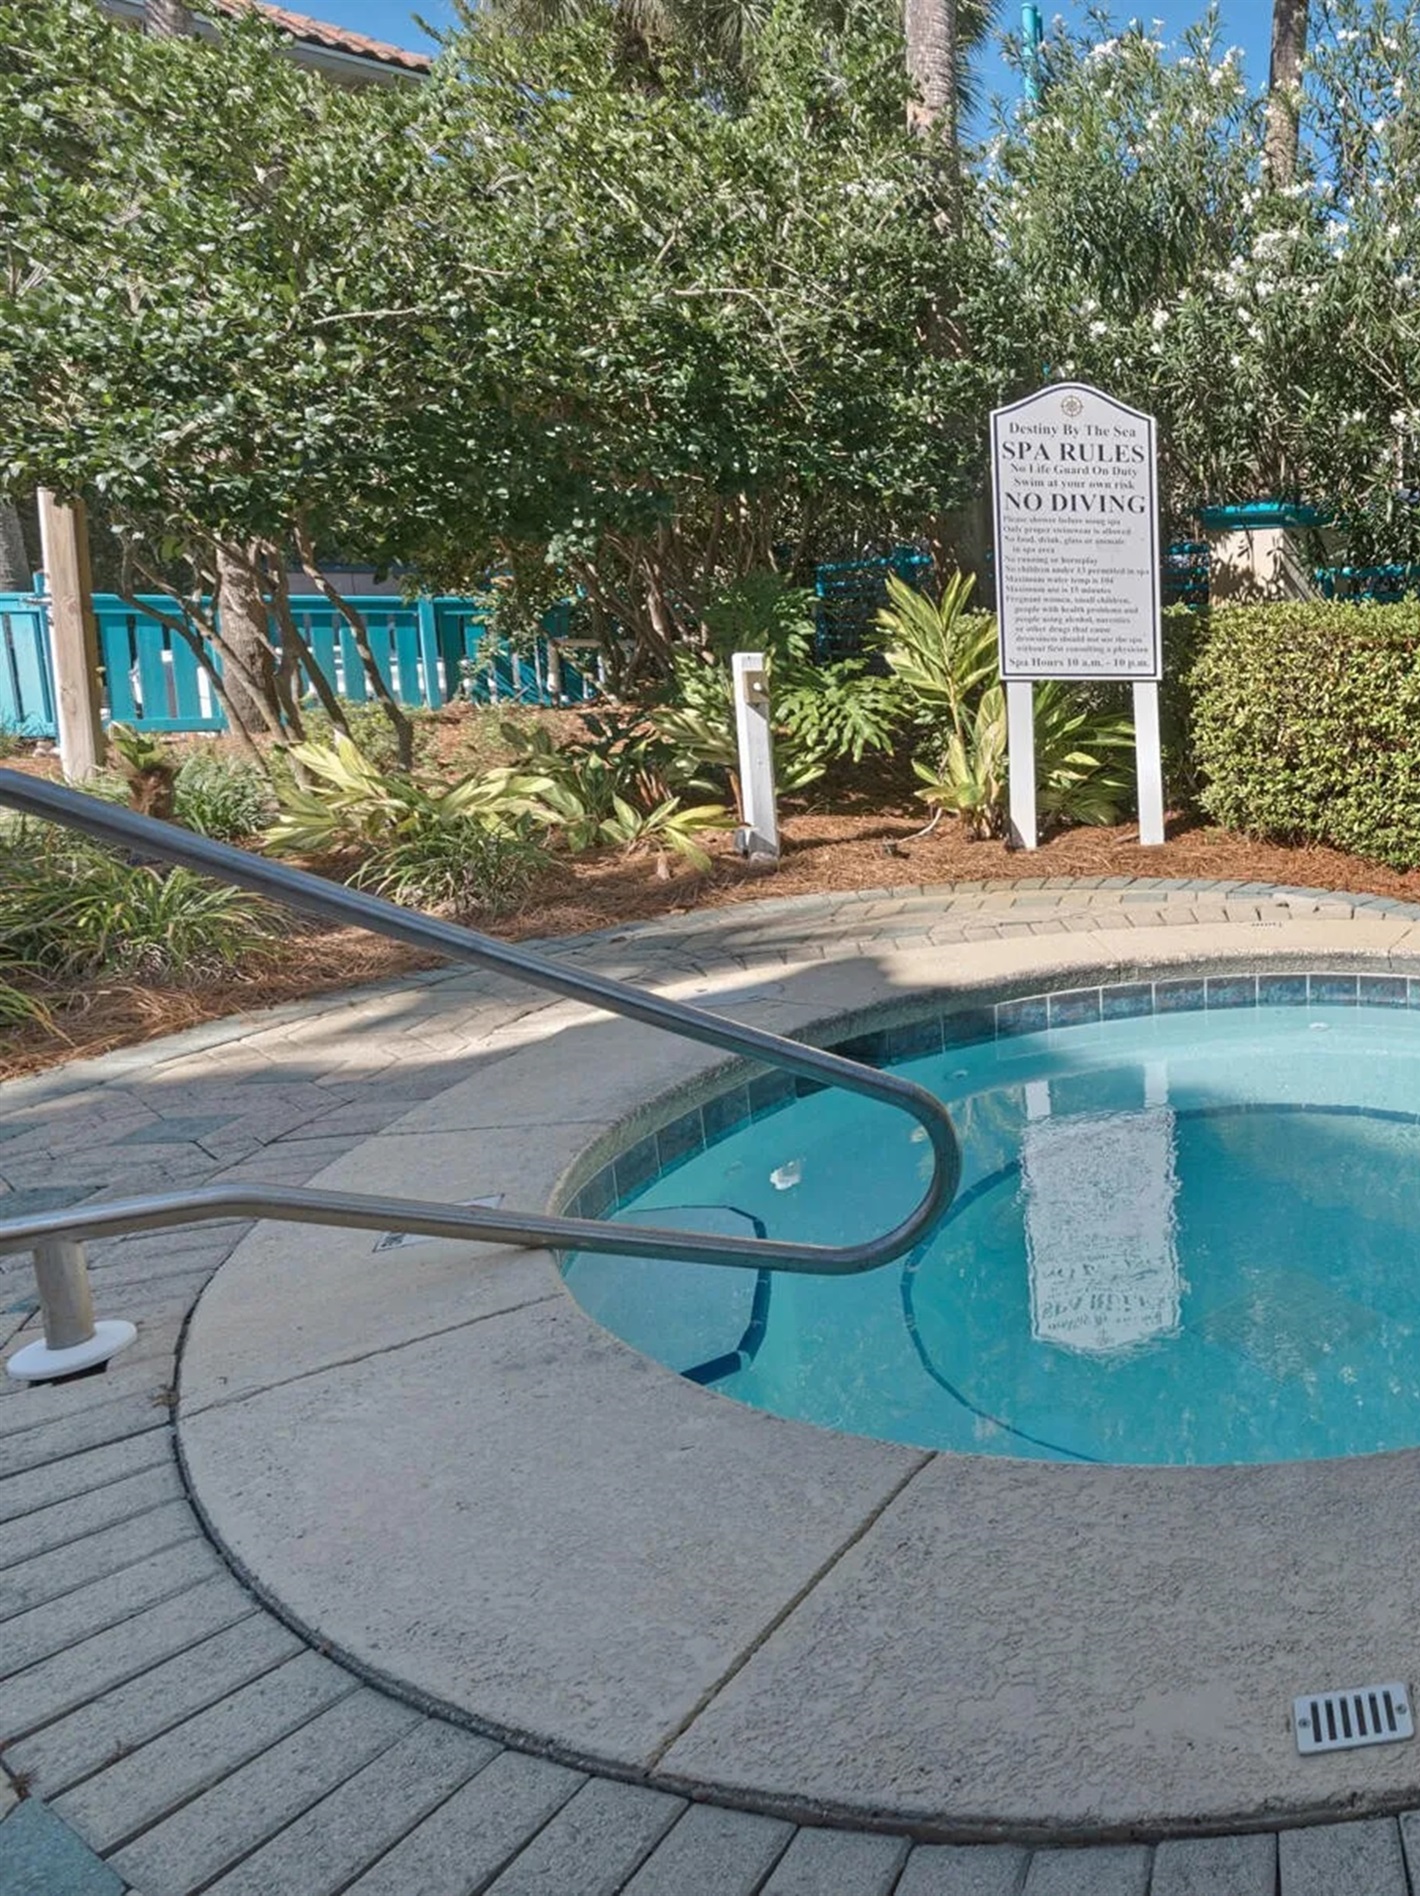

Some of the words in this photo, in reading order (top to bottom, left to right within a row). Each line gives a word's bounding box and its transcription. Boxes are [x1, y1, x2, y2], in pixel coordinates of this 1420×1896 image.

[1010, 422, 1057, 438] Destiny
[1063, 424, 1080, 438] By
[1085, 425, 1110, 436] The
[1113, 426, 1136, 437] Sea
[1003, 442, 1050, 460] SPA
[1061, 443, 1144, 462] RULES
[1011, 463, 1026, 473] No
[1030, 464, 1051, 473] Life
[1054, 465, 1089, 474] Guard
[1093, 467, 1109, 475] On
[1113, 467, 1137, 477] Duty
[1014, 478, 1044, 486] Swim
[1061, 481, 1085, 489] your
[1114, 481, 1134, 489] risk
[1005, 493, 1042, 510] NO
[1052, 493, 1145, 513] DIVING
[1009, 658, 1028, 668] Spa
[1032, 658, 1064, 666] Hours
[1068, 658, 1079, 666] 10
[1114, 658, 1125, 666] 10
